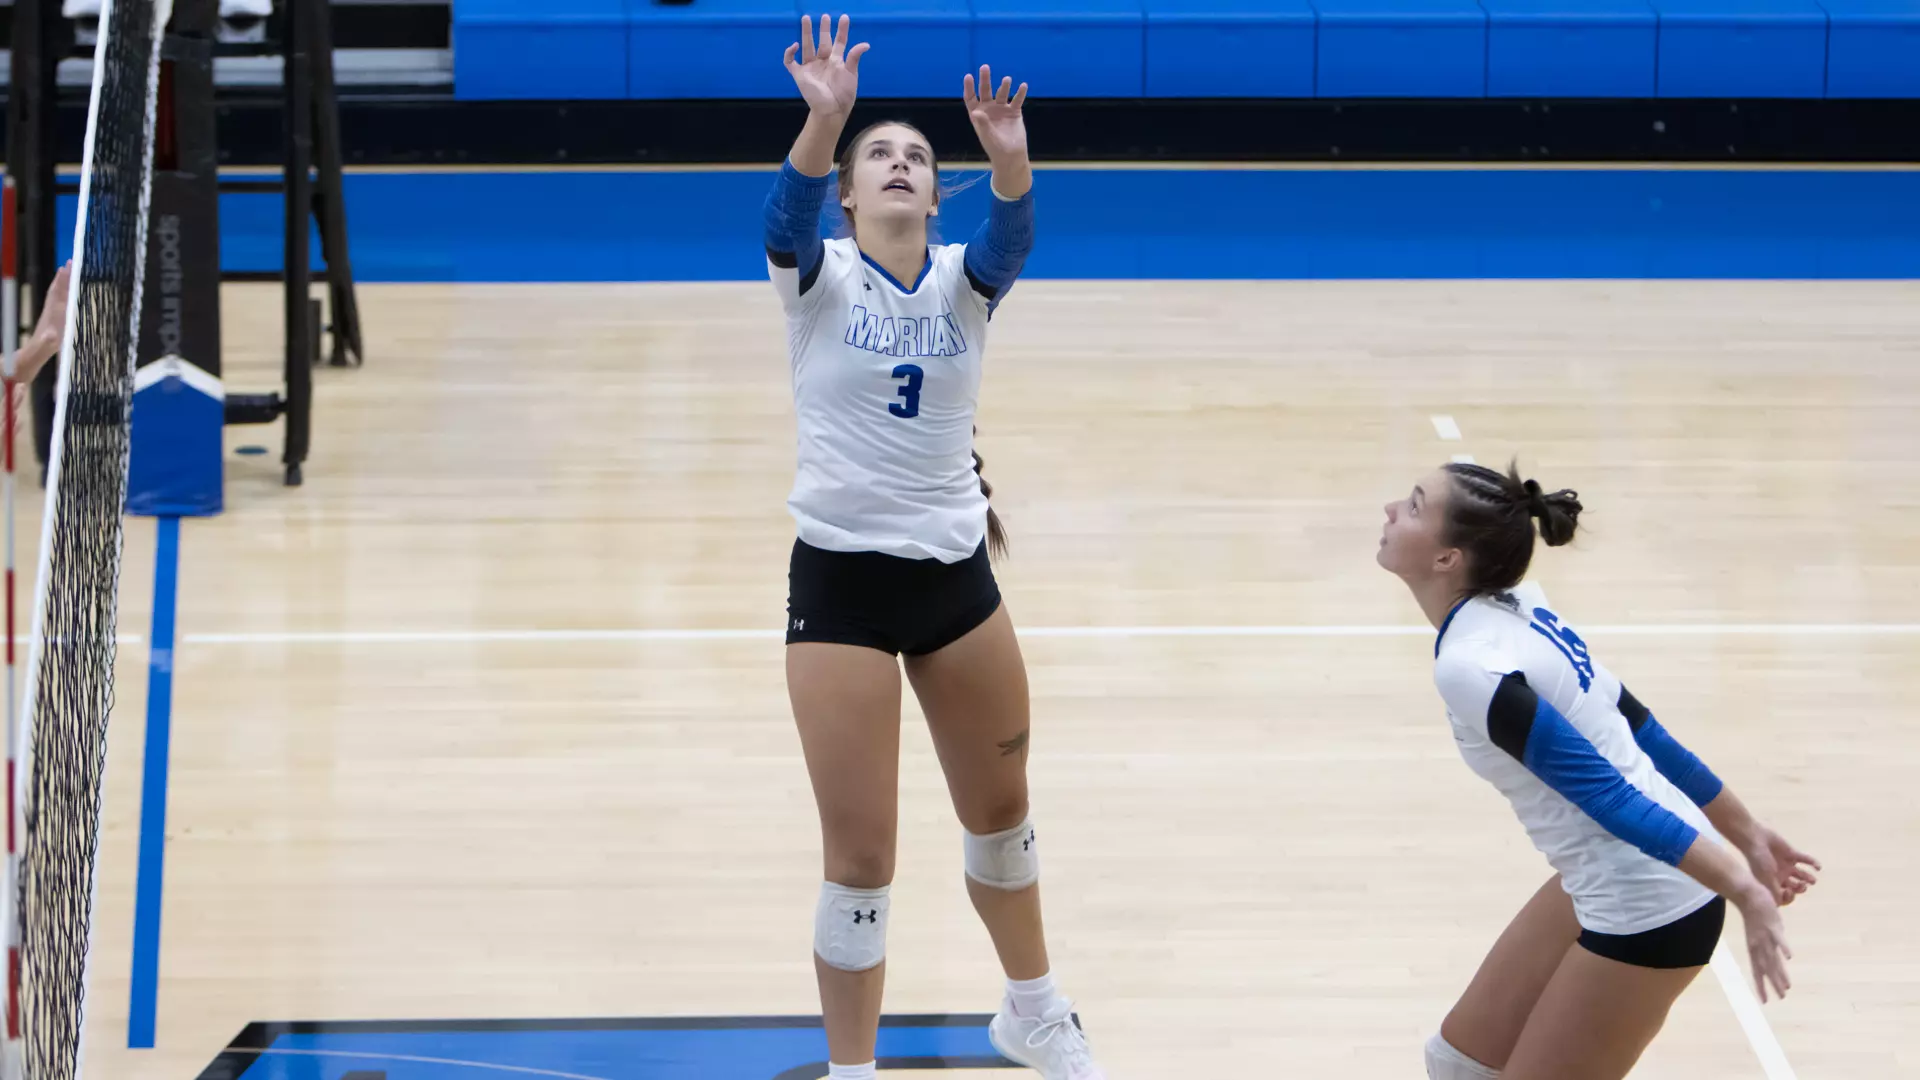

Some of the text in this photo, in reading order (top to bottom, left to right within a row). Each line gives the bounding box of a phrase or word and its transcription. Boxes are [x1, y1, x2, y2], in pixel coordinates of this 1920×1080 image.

[156, 215, 182, 294] sports
[844, 305, 967, 358] MARIAN
[888, 364, 924, 418] 3
